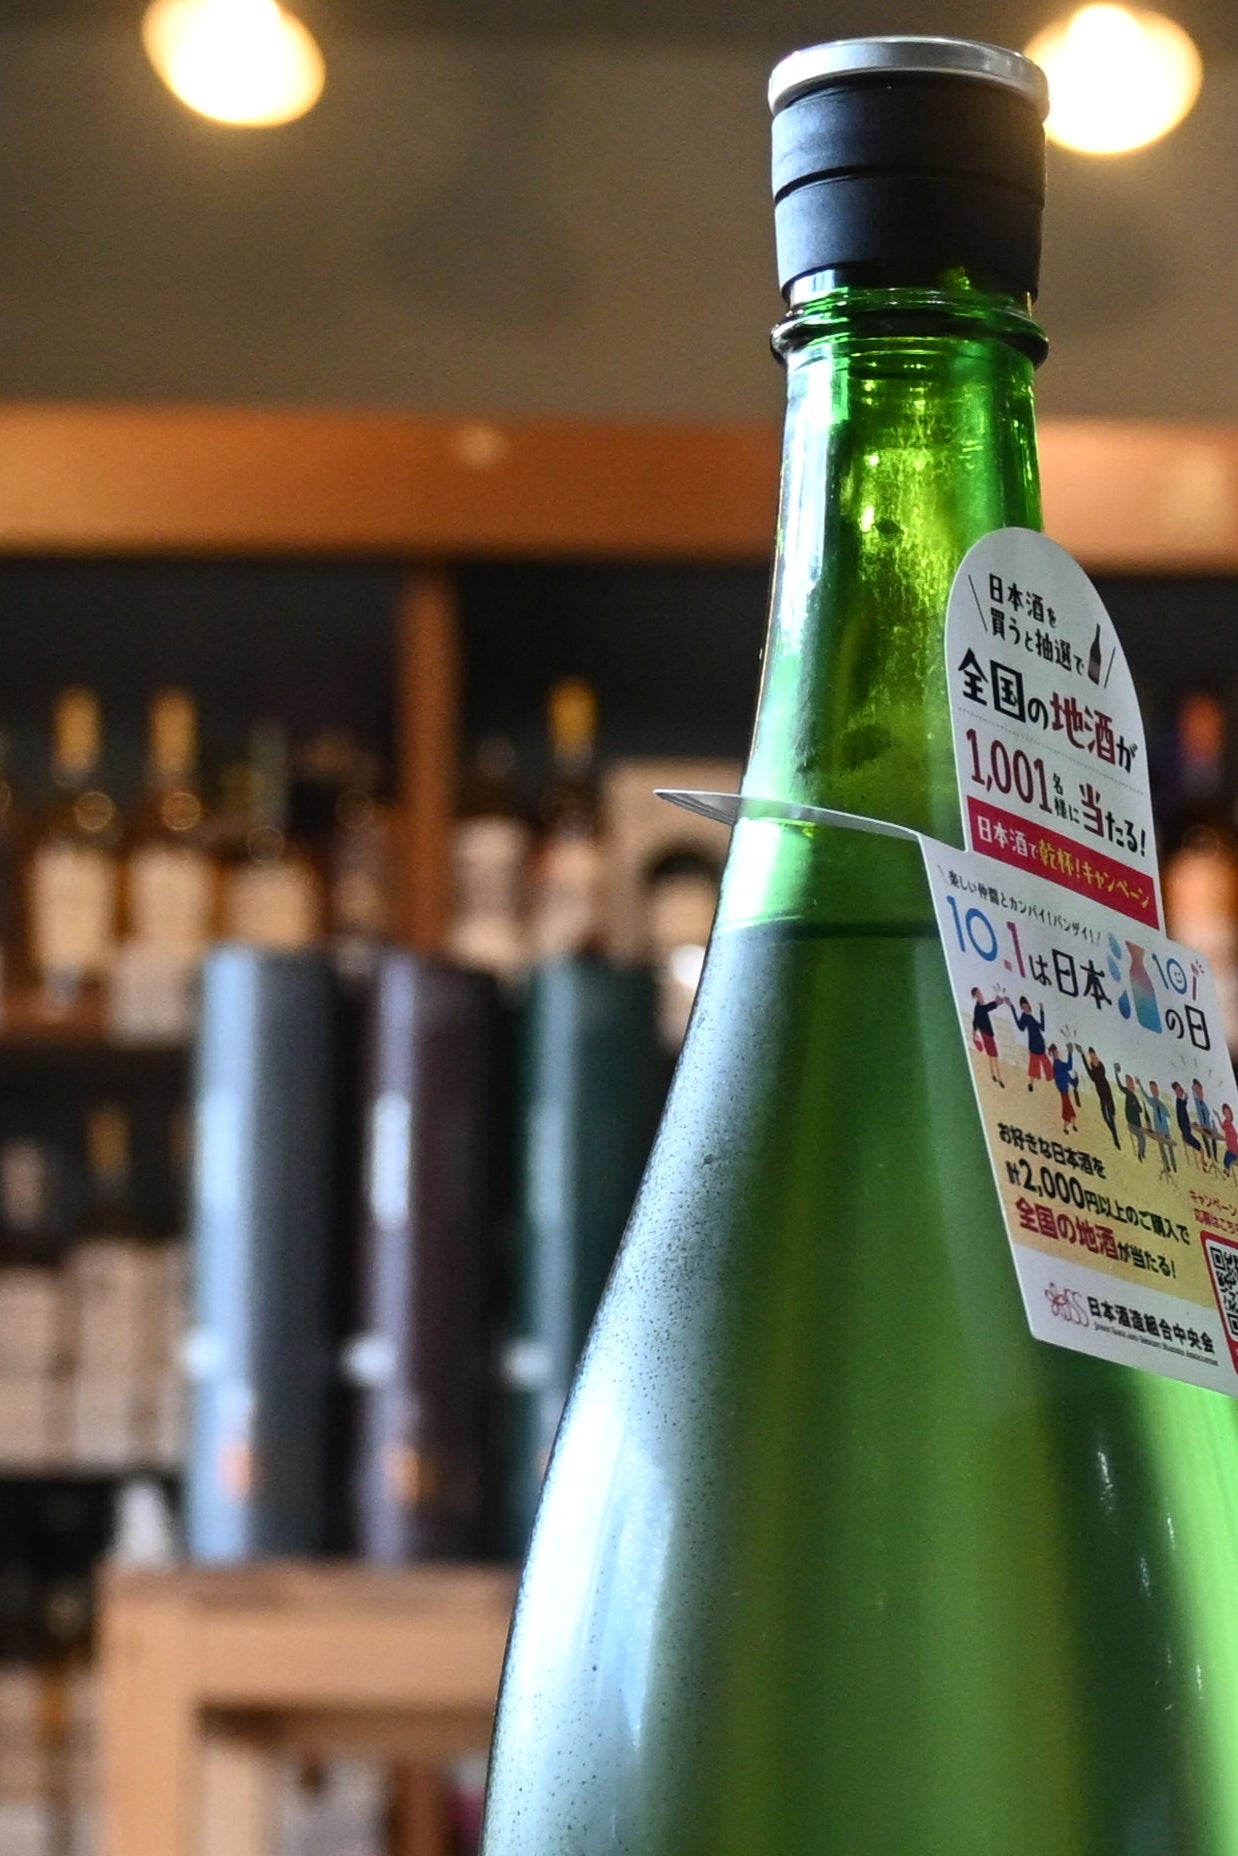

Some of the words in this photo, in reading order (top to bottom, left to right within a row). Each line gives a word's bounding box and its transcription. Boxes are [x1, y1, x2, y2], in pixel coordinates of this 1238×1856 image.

[990, 574, 1057, 628] 日本酒を
[990, 608, 1086, 677] 買うと抽選で
[958, 648, 1138, 774] 全国の地酒が
[998, 1122, 1106, 1179] お好きな日本酒を
[1087, 1296, 1216, 1354] 日本酒造組合中央会
